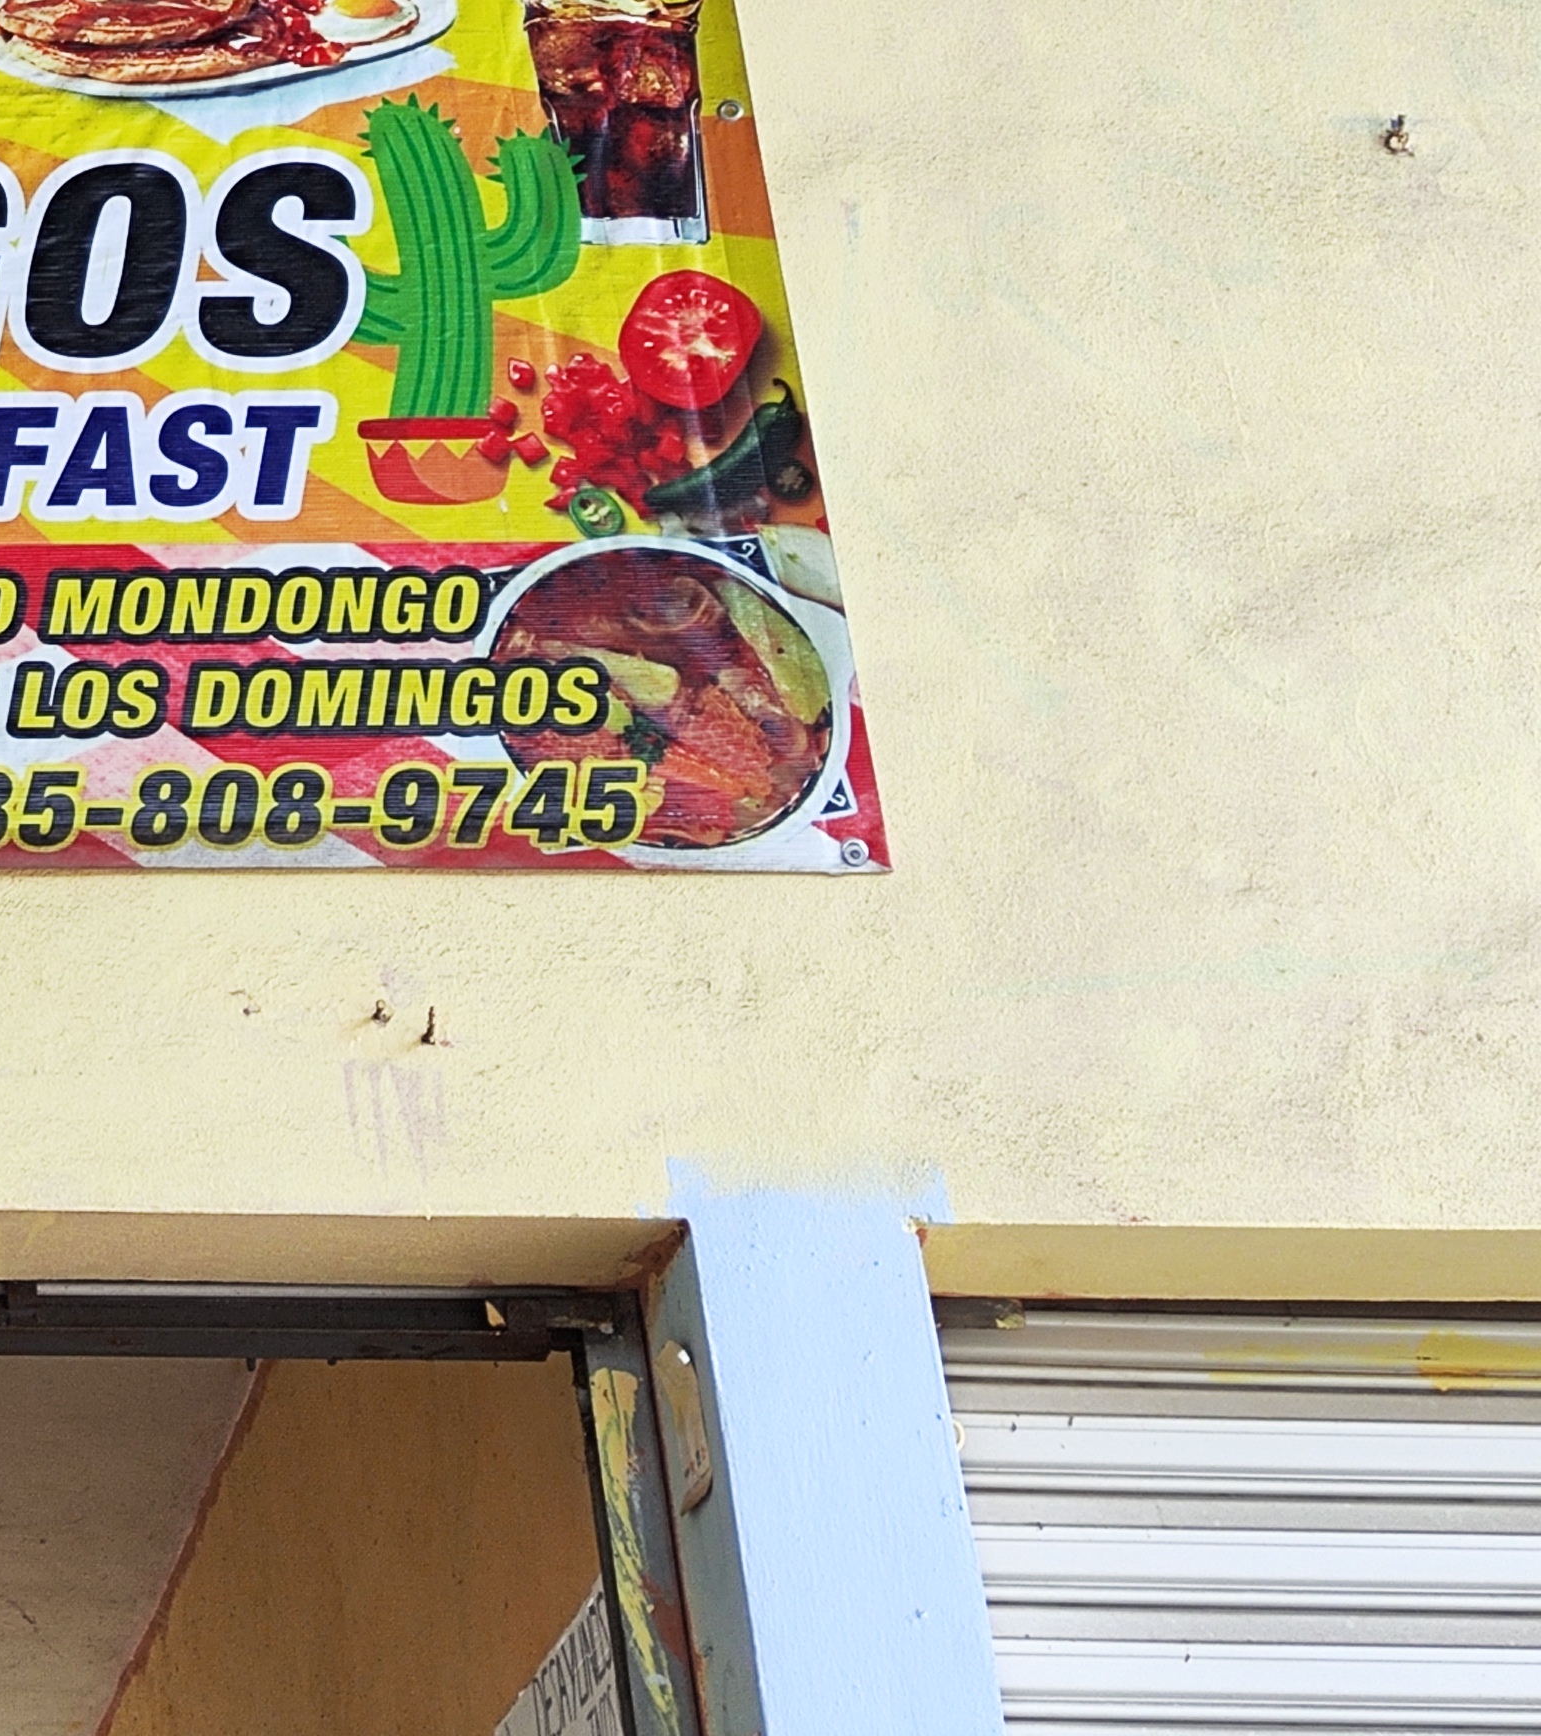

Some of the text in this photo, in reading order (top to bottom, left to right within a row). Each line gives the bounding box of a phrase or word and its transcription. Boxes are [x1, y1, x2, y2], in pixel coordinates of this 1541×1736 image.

[51, 575, 481, 638] MONDONGO
[15, 668, 164, 731] LOS
[184, 668, 602, 729] DOMINGOS
